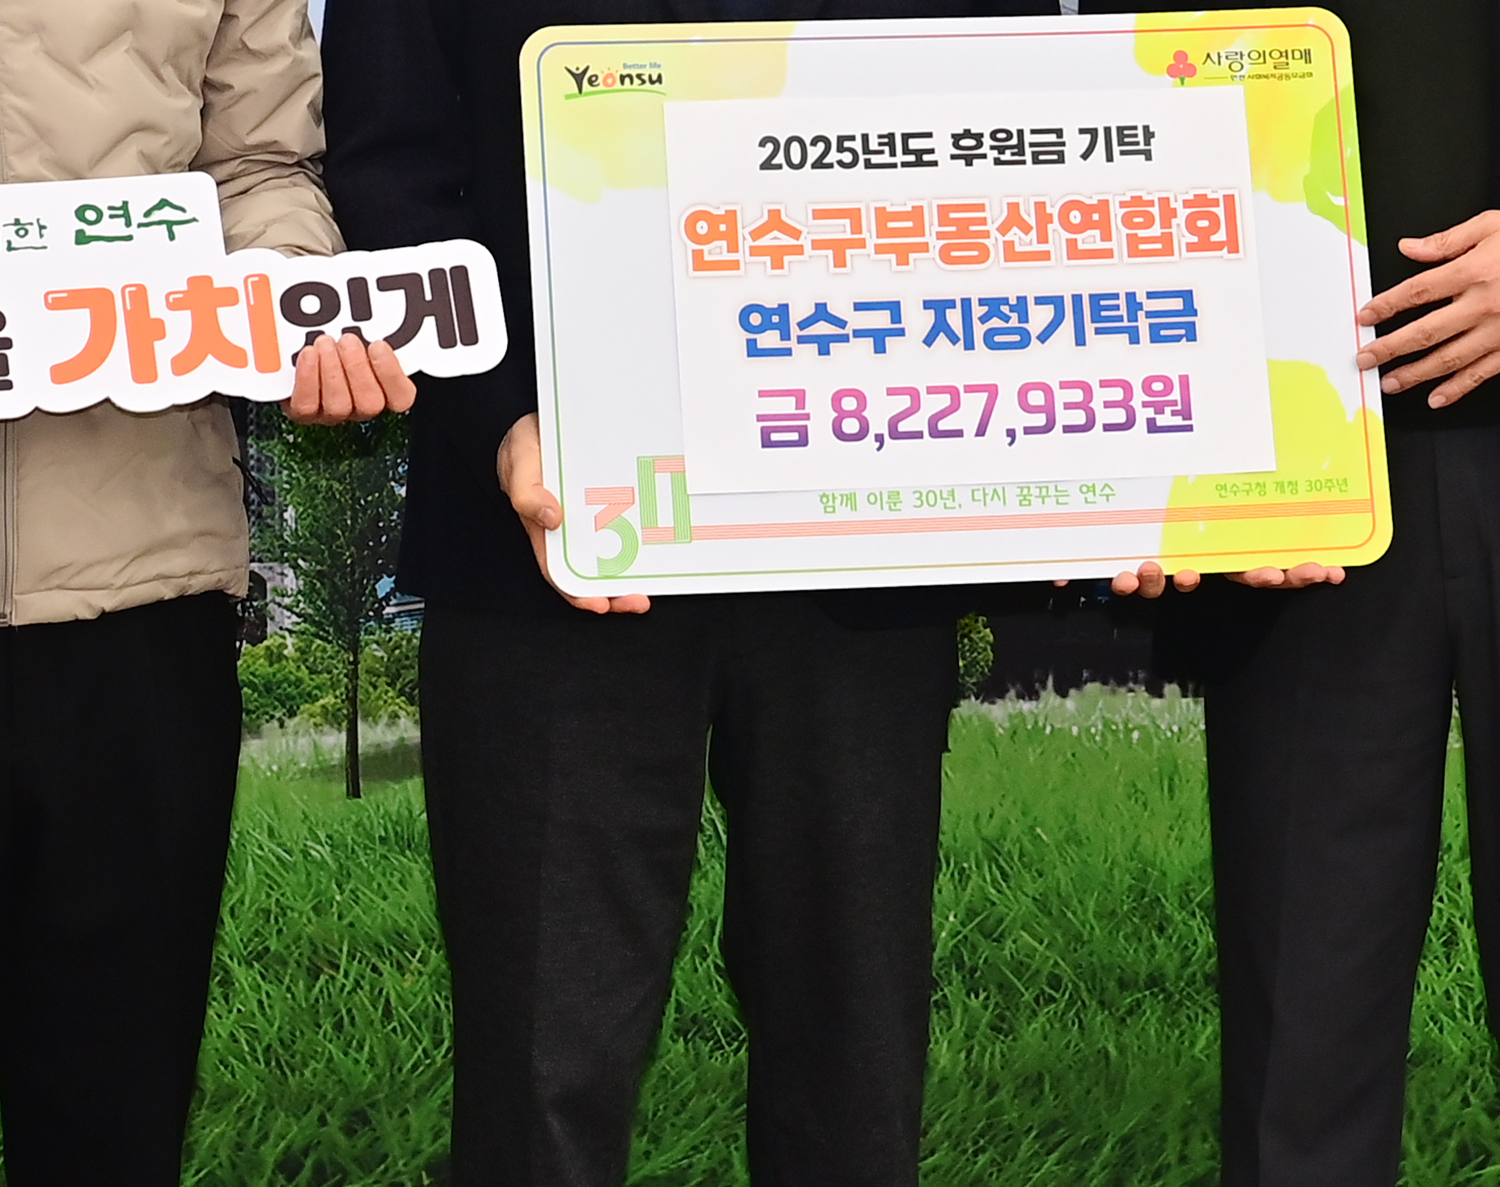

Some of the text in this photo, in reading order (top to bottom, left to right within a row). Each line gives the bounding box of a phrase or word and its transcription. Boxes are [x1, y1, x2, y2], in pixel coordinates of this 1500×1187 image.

[564, 65, 663, 95] Yeonsu
[1202, 48, 1312, 73] 사랑의열매
[757, 124, 1156, 171] 2025년도 후원금 기탁
[74, 198, 199, 246] 연수
[683, 192, 1240, 272] 연수구부동산연합회
[738, 288, 1198, 358] 연수구 지정기탁금
[755, 373, 1194, 452] 금 8,227,933원
[818, 482, 1117, 514] 함께 이룬 30년, 다시 꿈꾸는 연수
[1215, 477, 1348, 498] 연수구청 개청 30주년
